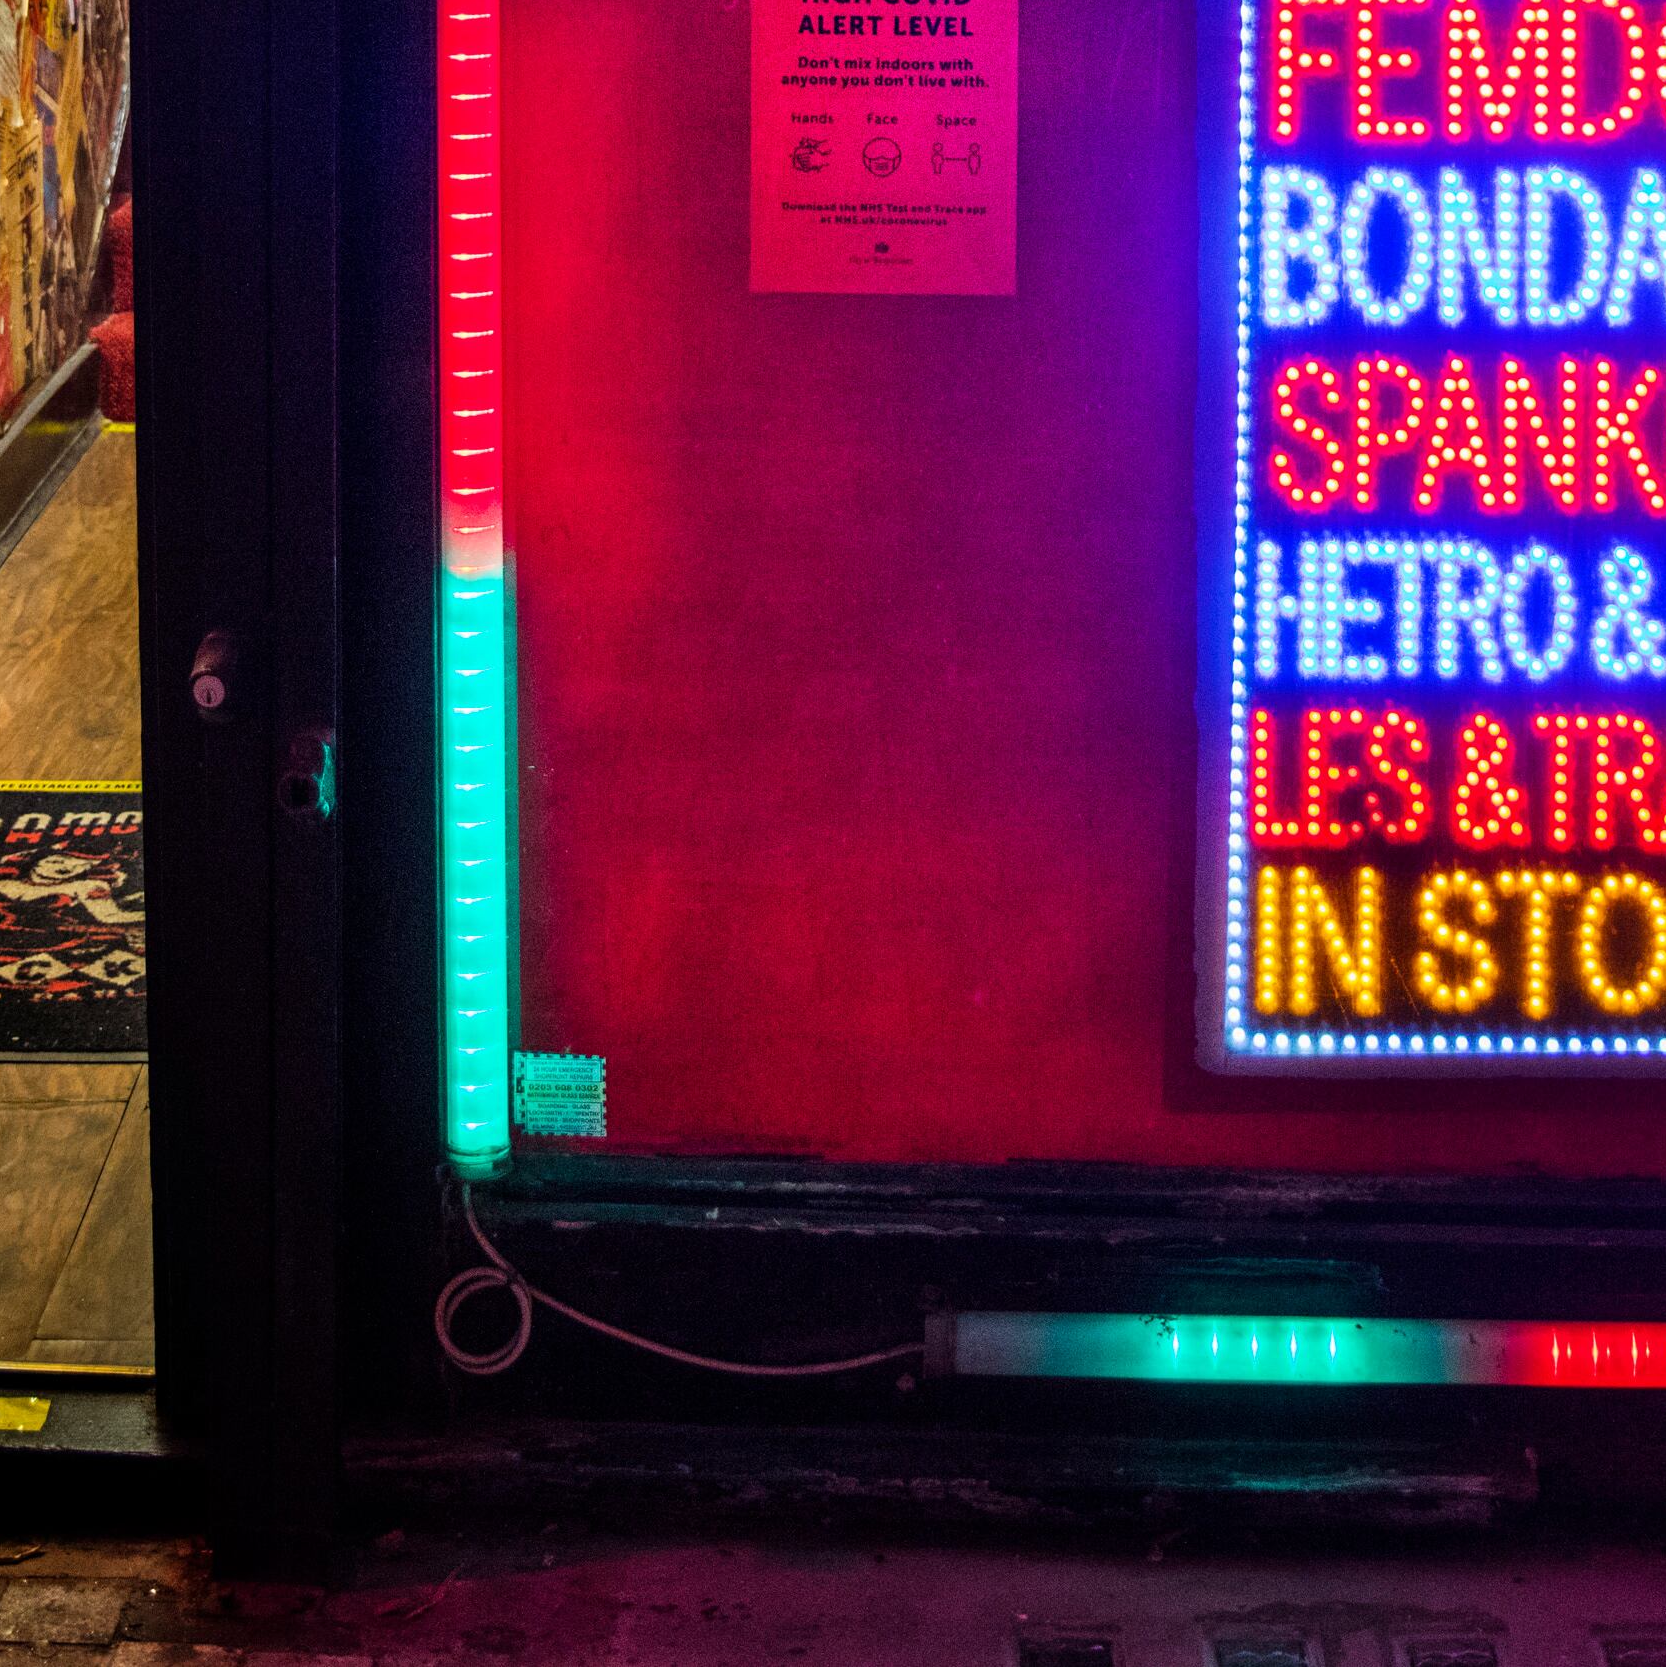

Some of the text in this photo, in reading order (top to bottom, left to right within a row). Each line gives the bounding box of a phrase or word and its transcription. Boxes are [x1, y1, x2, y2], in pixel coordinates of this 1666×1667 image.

[798, 15, 973, 37] ALERT LEVEL
[798, 56, 973, 72] Don't mix indoors with
[781, 74, 990, 90] anyone you don't live with.
[790, 113, 833, 125] Hands
[866, 113, 898, 126] Face
[935, 114, 977, 130] Space
[1257, 539, 1575, 679] HETRO
[1251, 706, 1430, 848] LES
[1455, 711, 1532, 850] &
[1255, 865, 1380, 1017] IN
